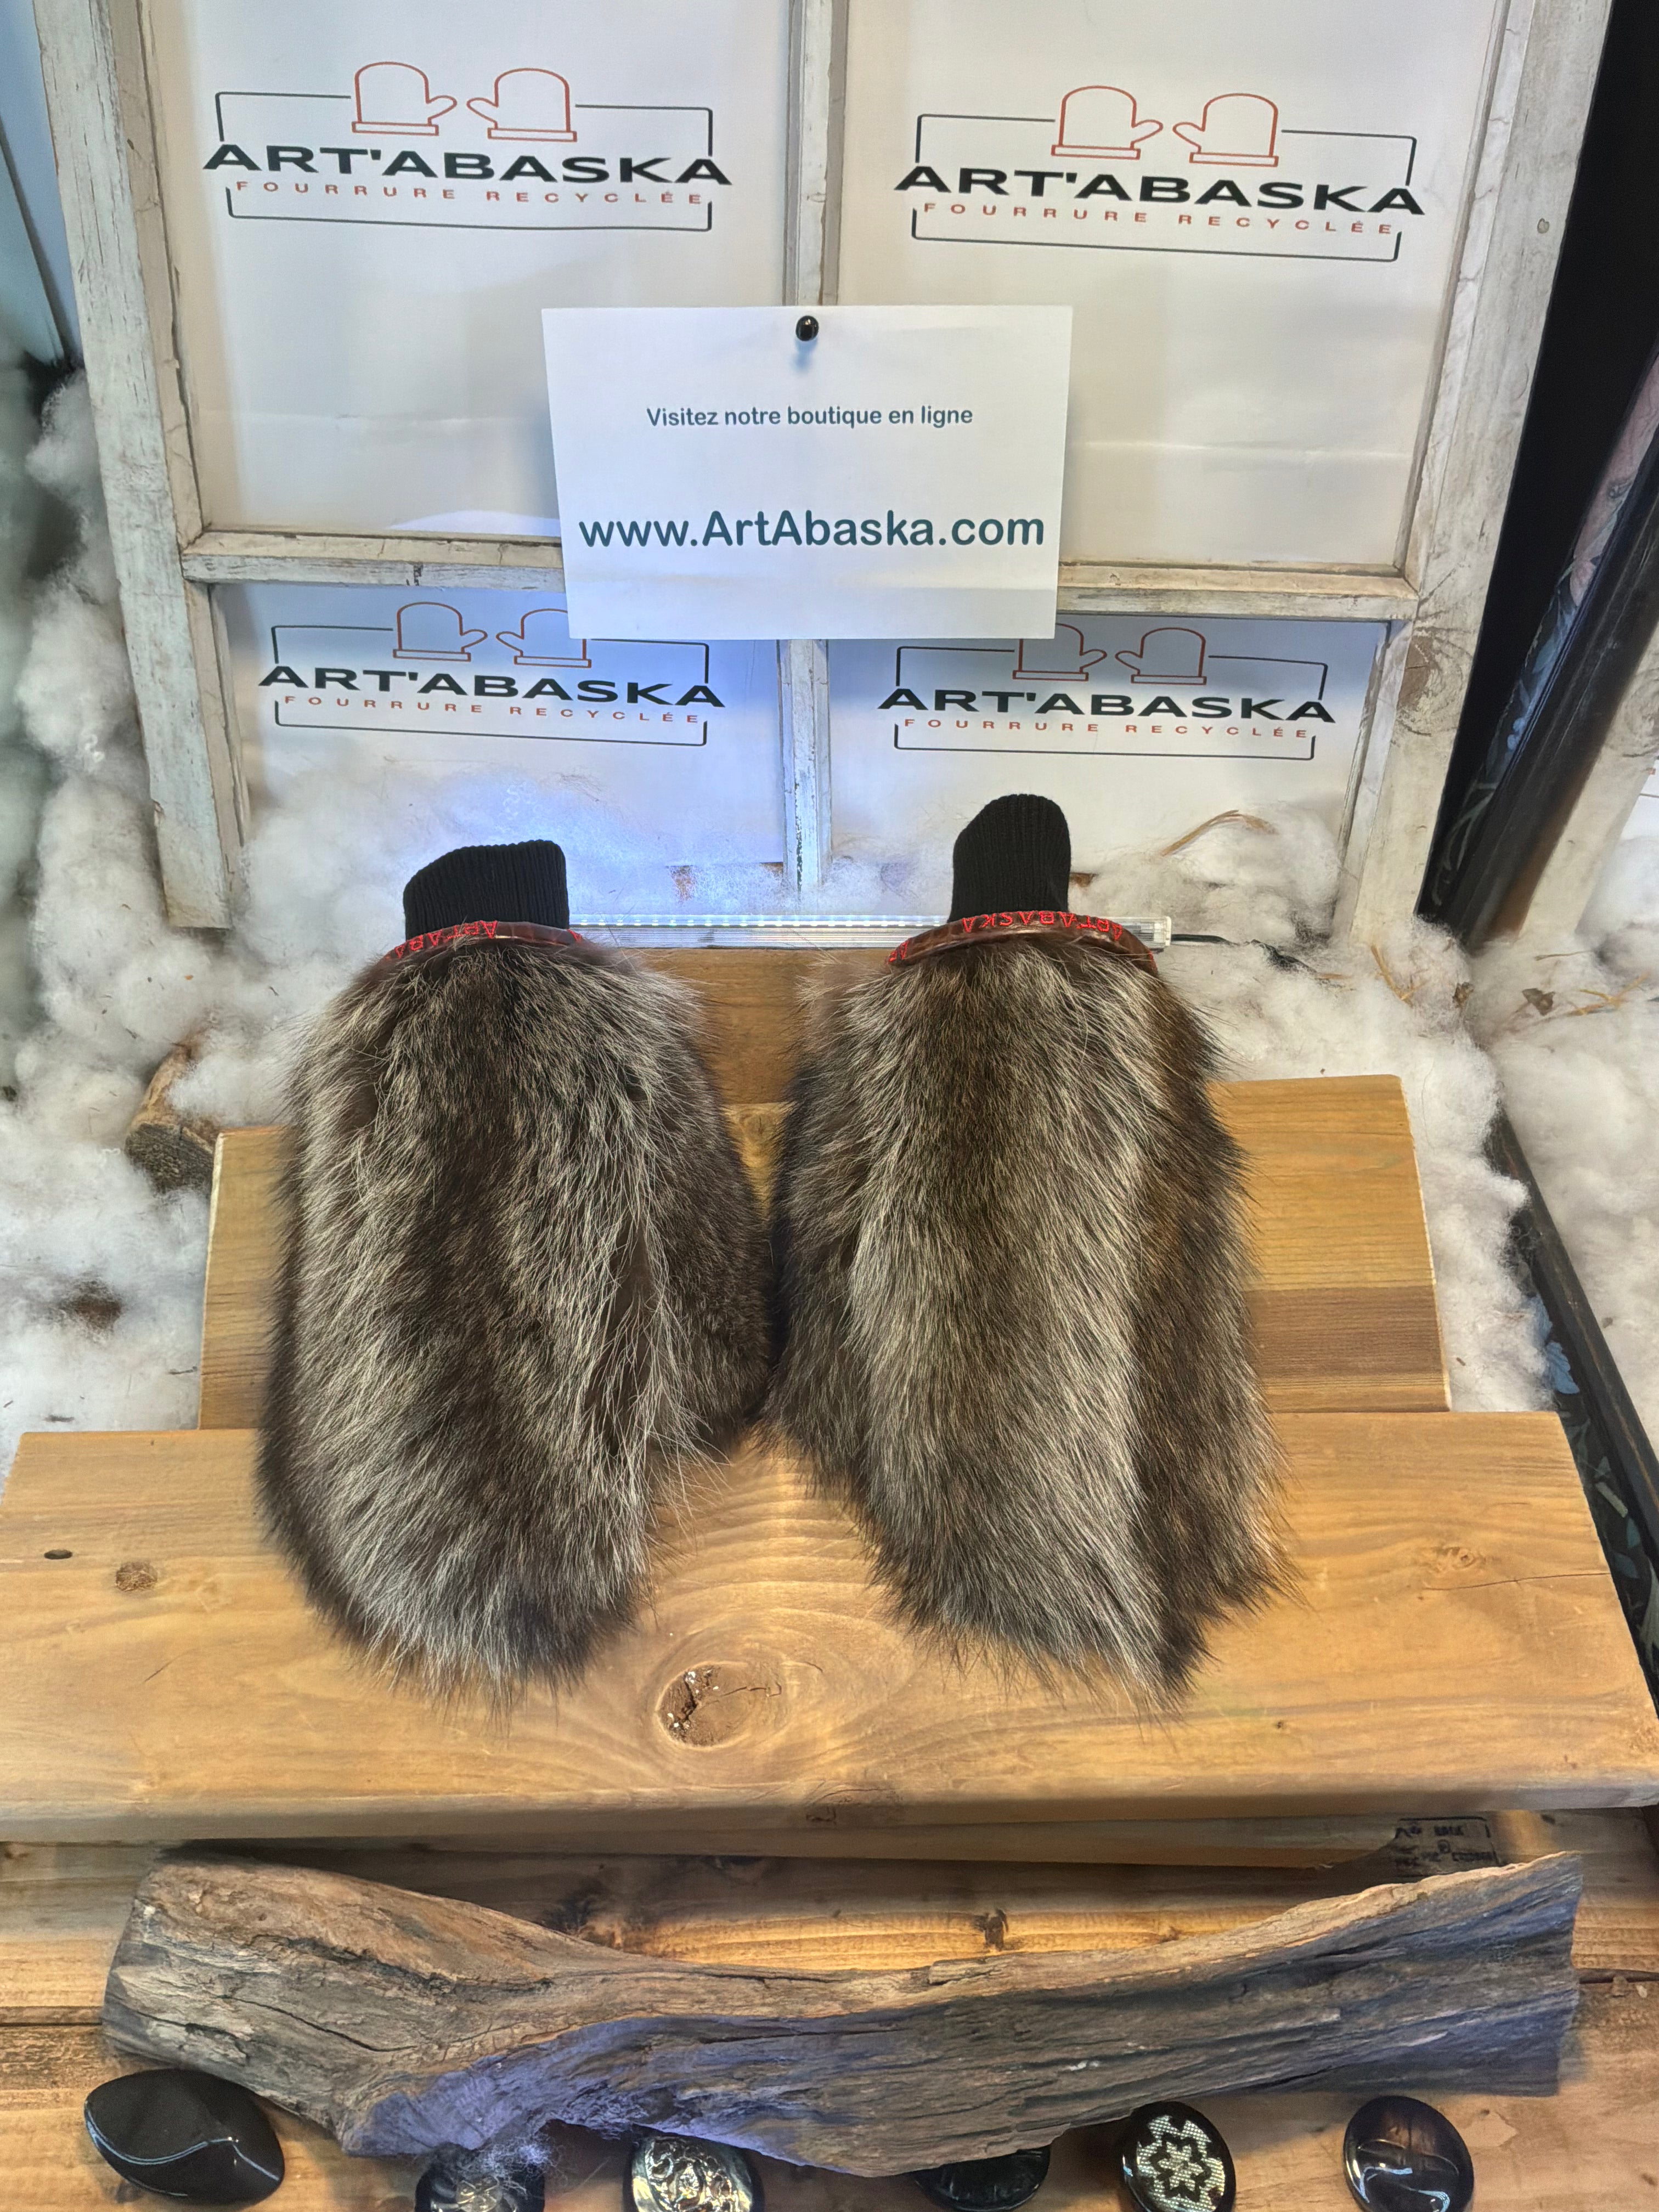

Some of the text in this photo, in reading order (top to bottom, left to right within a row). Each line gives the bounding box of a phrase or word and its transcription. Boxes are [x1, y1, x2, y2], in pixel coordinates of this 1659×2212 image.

[203, 144, 732, 186] ART'ABASKA
[236, 180, 702, 205] FOURRURE RECYCLÉE
[895, 165, 1425, 215] ART'ABASKA
[924, 202, 1391, 235] FOURRURE RECYCLÉE
[646, 405, 973, 429] Visitez notre boutique en ligne
[578, 509, 1045, 548] www.ArtAbaska.com
[258, 665, 725, 708] ART'ABASKA
[284, 696, 698, 724] FOURRURE RECYCLÉE
[877, 687, 1336, 723] ART'ABASKA
[904, 719, 1307, 738] FOURRURE RECYCLÉE
